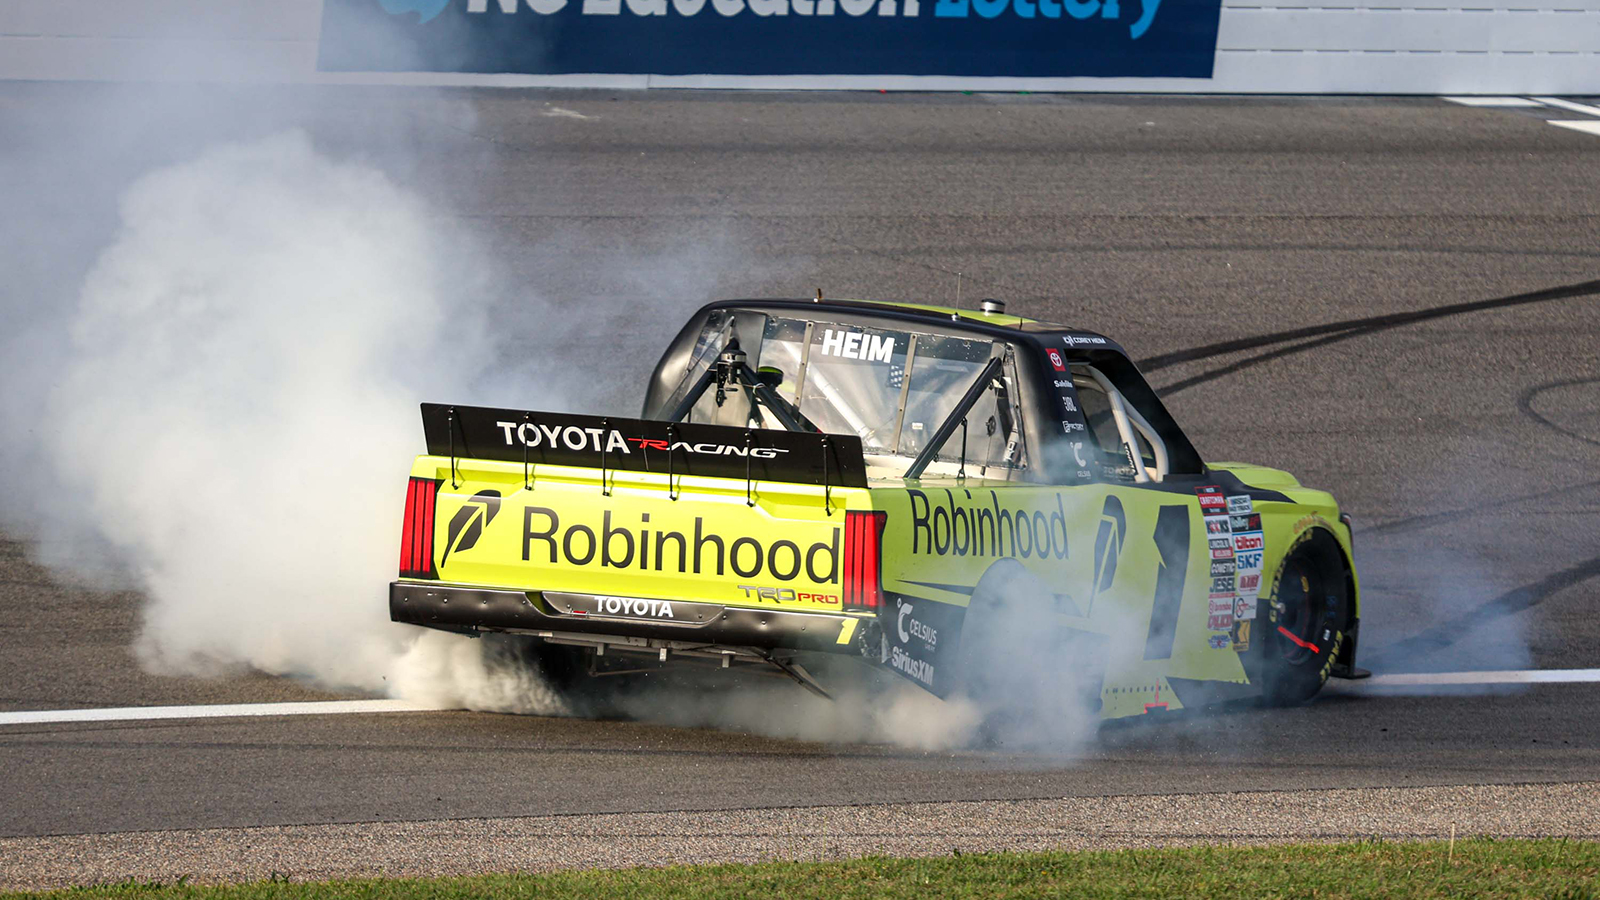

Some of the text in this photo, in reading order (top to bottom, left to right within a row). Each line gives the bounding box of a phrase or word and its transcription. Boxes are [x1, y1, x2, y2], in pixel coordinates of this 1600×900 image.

[821, 329, 896, 363] HEIM
[496, 420, 790, 459] TOYOTA RACING
[906, 489, 1070, 560] Robinhood
[521, 505, 841, 585] Robinhood
[1235, 536, 1262, 550] tilton
[1211, 562, 1236, 574] COMETIC
[1237, 553, 1262, 570] SKF
[738, 584, 839, 605] TRD PRO
[1143, 504, 1191, 661] 1
[1209, 577, 1237, 592] JESEL
[593, 596, 674, 618] TOYOTA
[836, 618, 860, 645] 1
[910, 618, 938, 645] CELSIUS
[891, 646, 935, 686] SiriusXM
